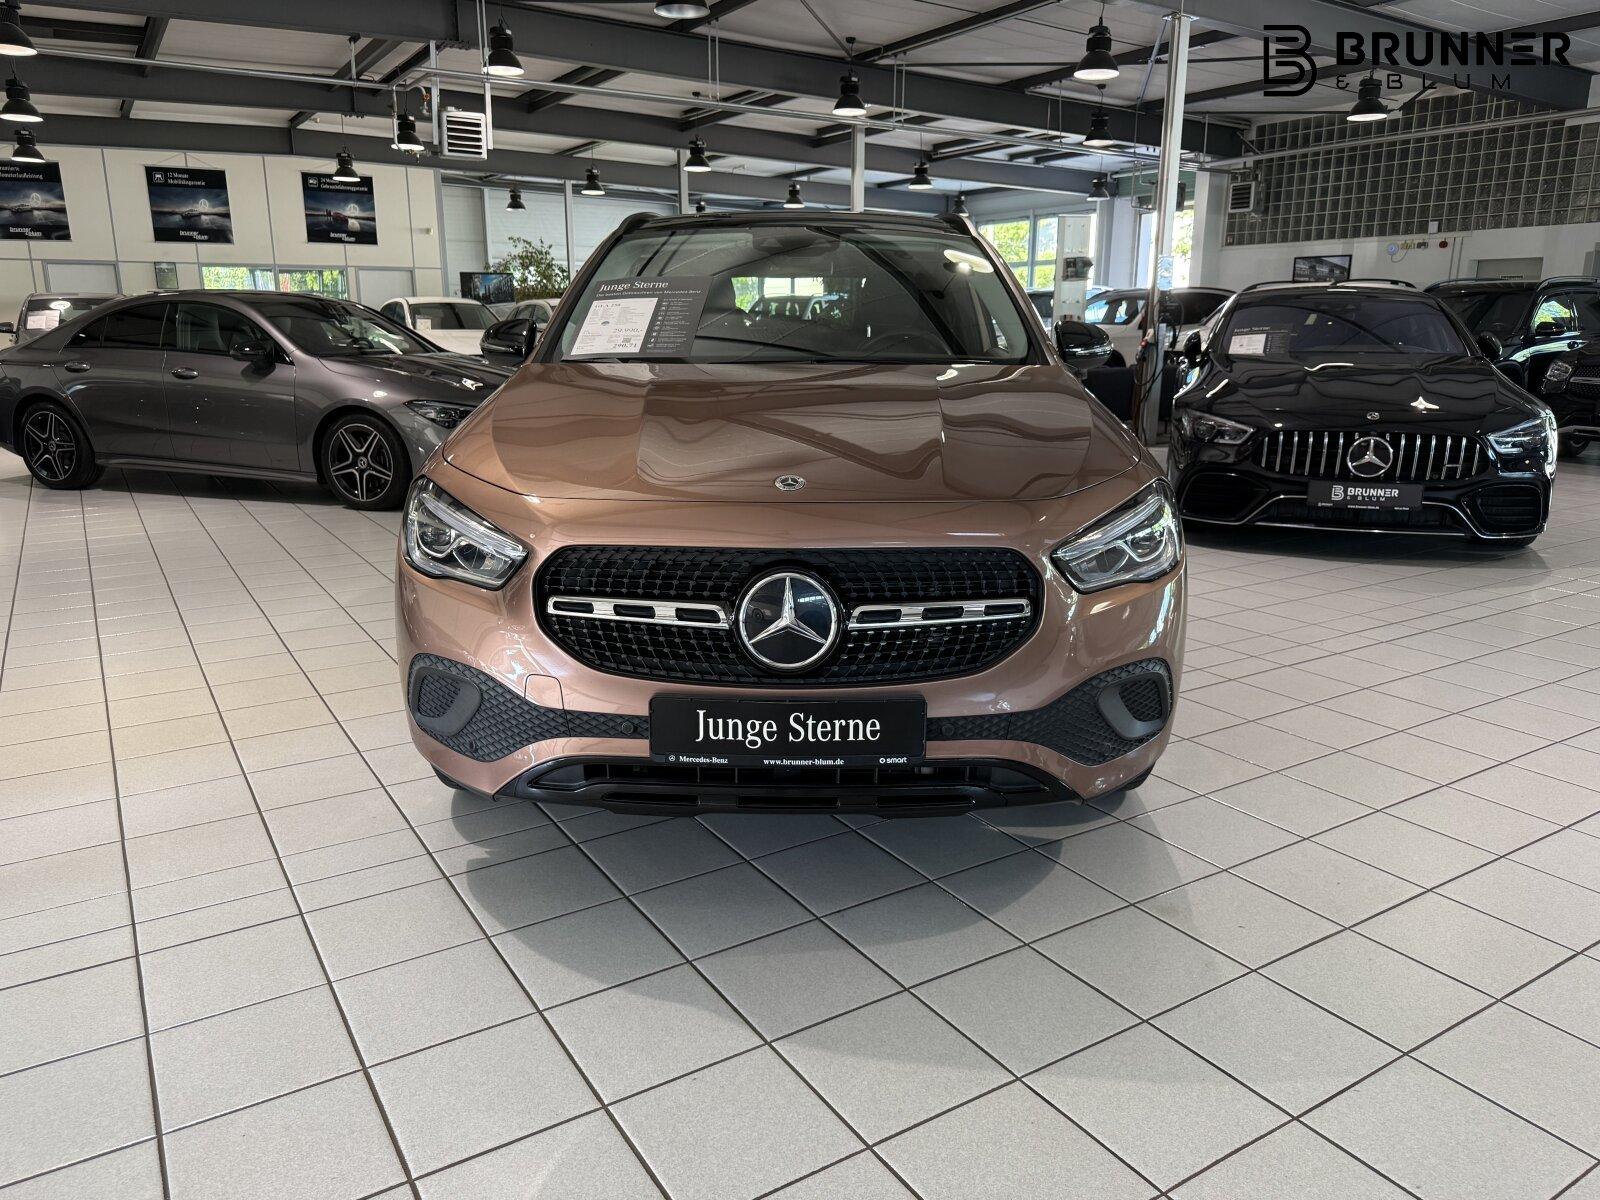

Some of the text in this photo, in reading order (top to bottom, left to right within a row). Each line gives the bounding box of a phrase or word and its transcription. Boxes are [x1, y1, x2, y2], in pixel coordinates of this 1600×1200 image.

[599, 280, 669, 292] Junge Sterne
[1347, 487, 1399, 498] BRUNNER
[695, 709, 881, 749] Junge Sterne
[679, 755, 728, 764] Mercedes-Benz
[763, 757, 845, 766] www.brunner-blum.de
[886, 756, 908, 764] smart
